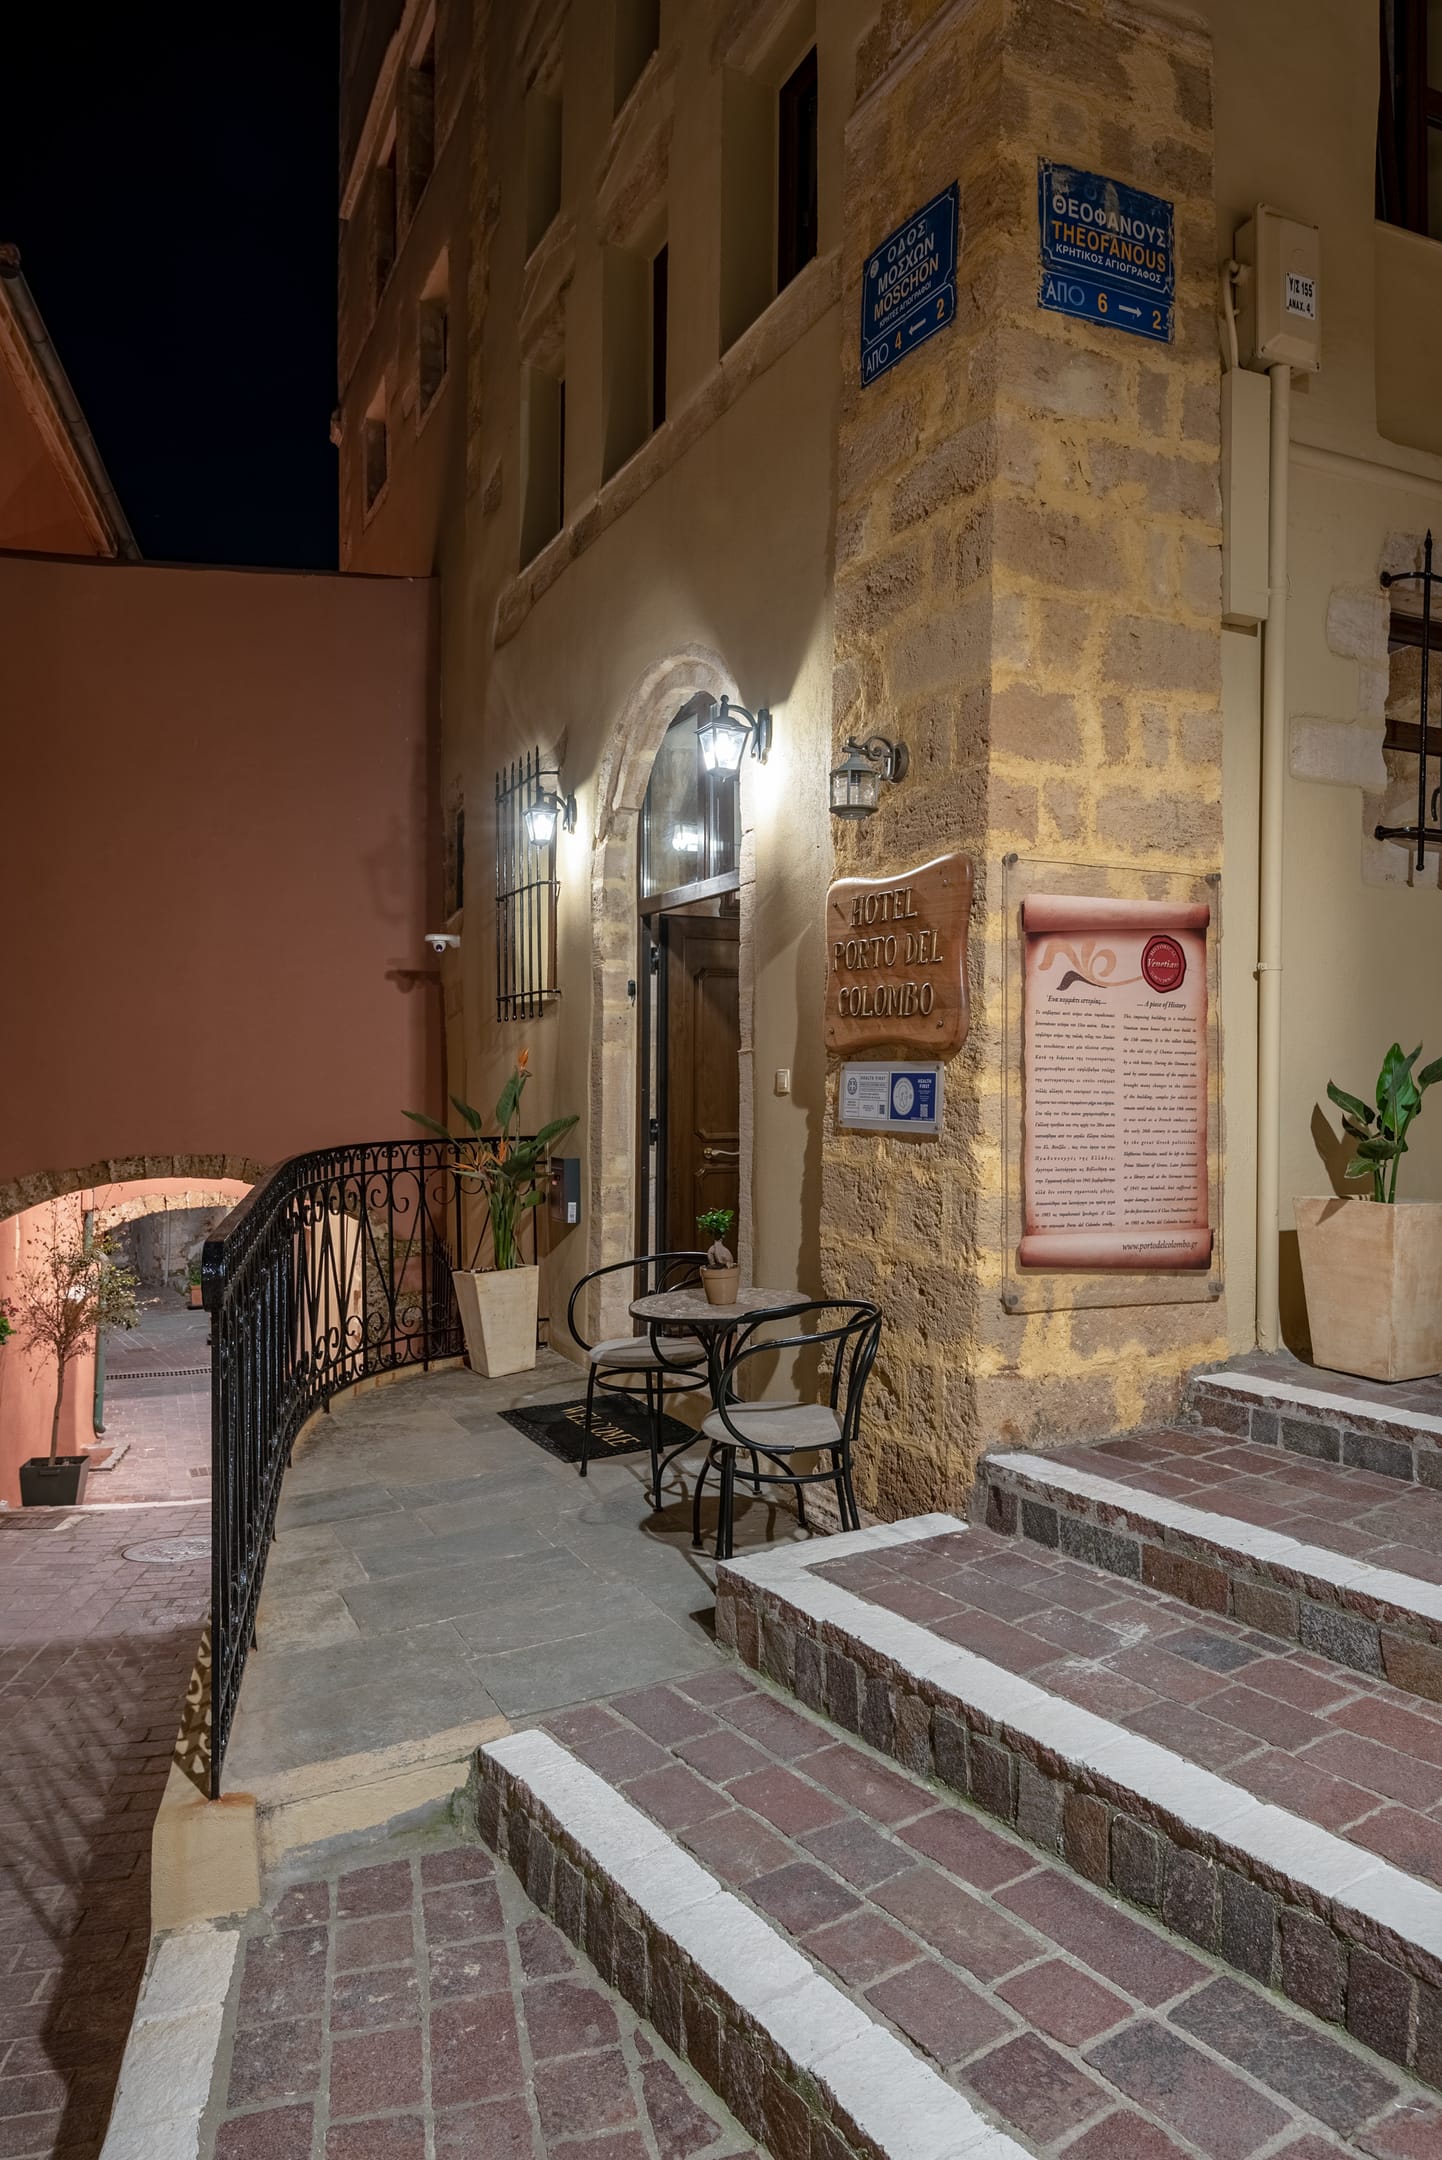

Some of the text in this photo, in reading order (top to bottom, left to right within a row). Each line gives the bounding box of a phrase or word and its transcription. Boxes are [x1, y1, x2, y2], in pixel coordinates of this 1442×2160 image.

[888, 219, 926, 262] ΟΔΟΣ
[1052, 194, 1166, 248] ΘΕΟΦΑΝΟΥΣ
[878, 232, 934, 295] ΜΟΣΧΩΝ
[1051, 220, 1166, 272] THEOFANOUS
[1056, 243, 1161, 284] ΚΡΗΤΙΚΟΣ ΑΓΙΟΓΡΑΦΟΣ
[874, 254, 939, 322] MOSCHON
[1046, 279, 1162, 330] ΑΠΟ 6 2
[1302, 282, 1312, 298] 155
[866, 298, 945, 376] ΑΠΟ 4 2
[850, 886, 918, 926] HOTEL
[832, 929, 944, 972] PORTO DEL
[1147, 958, 1180, 969] Venetian
[839, 982, 934, 1017] COLOMBO
[1162, 1000, 1168, 1010] of
[1168, 1001, 1186, 1010] History
[1122, 1240, 1198, 1252] www.portodelcolombo.gr
